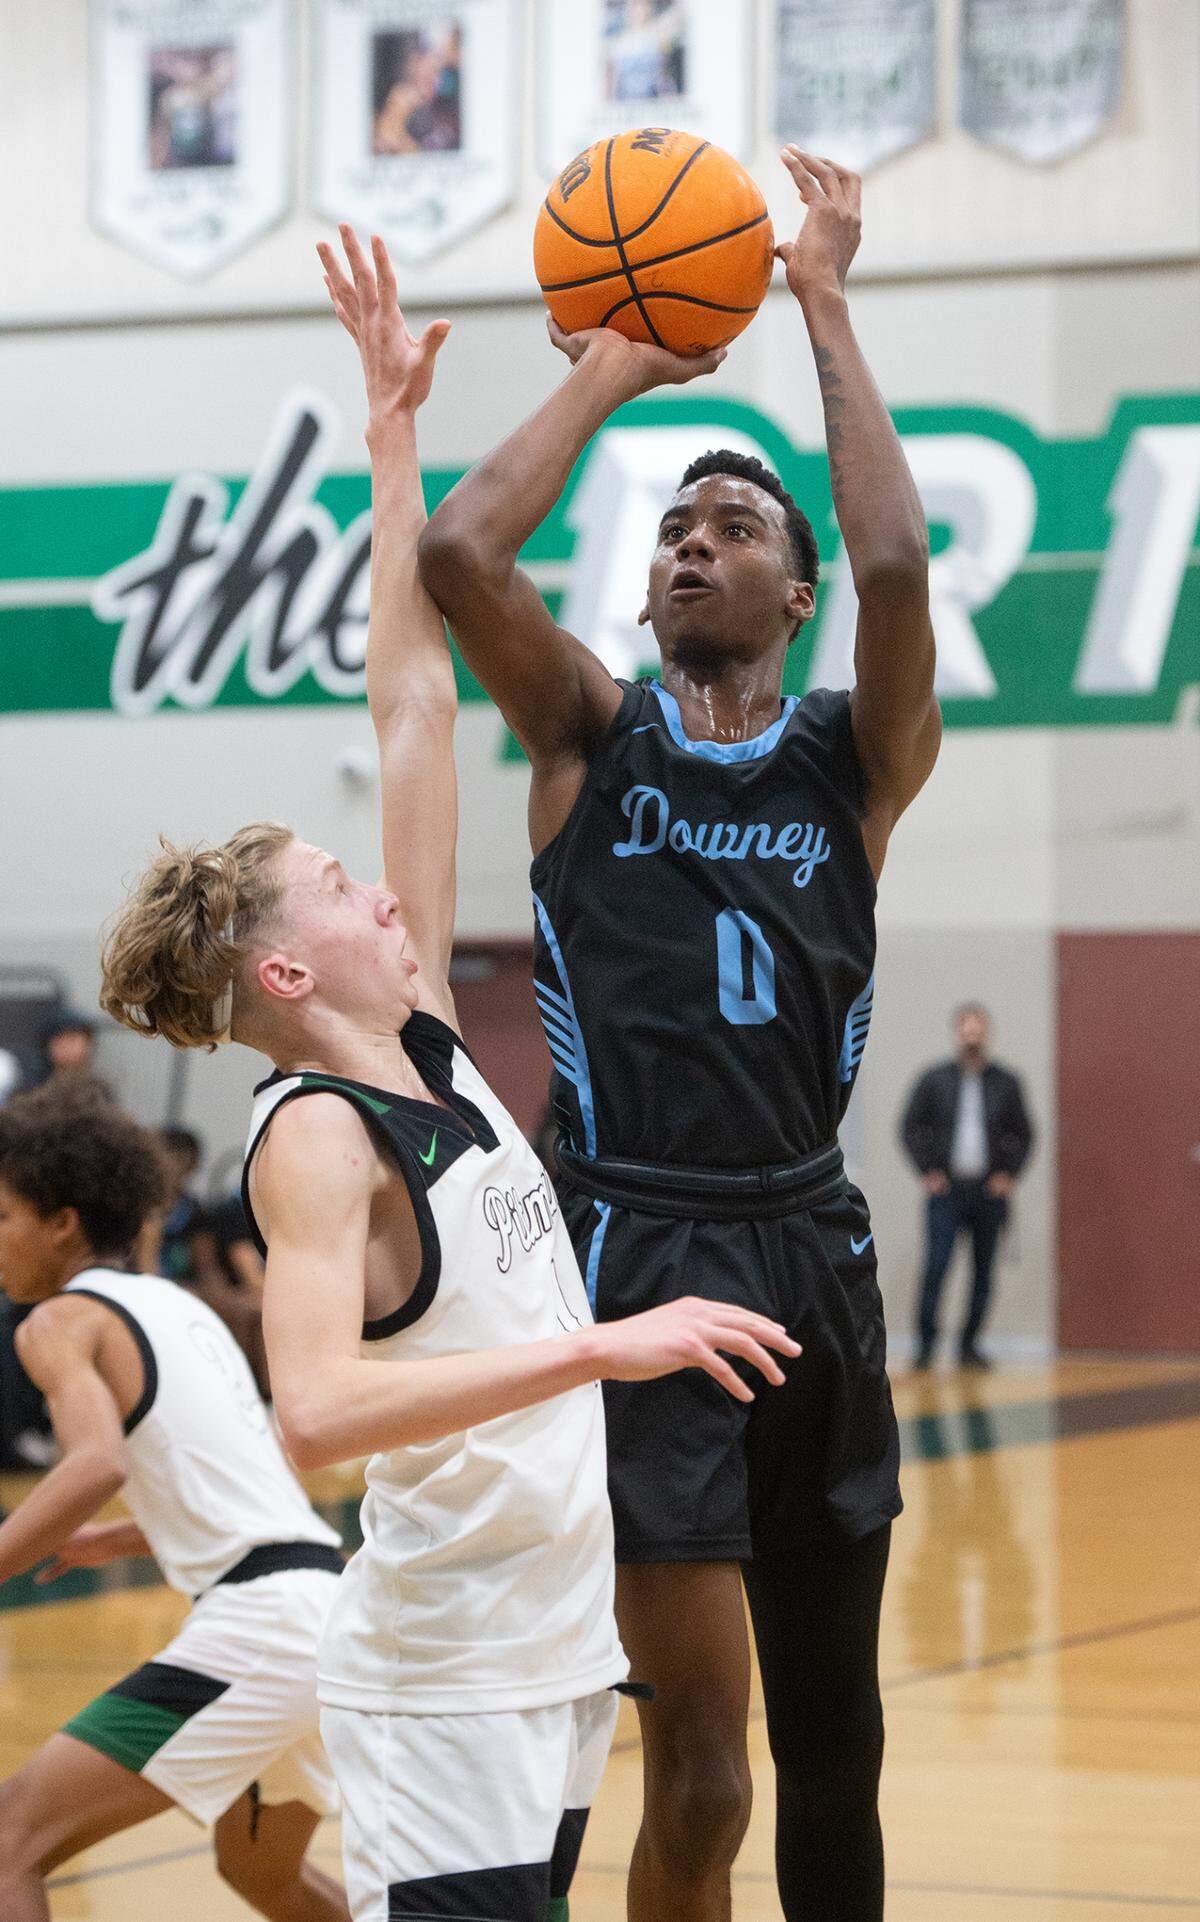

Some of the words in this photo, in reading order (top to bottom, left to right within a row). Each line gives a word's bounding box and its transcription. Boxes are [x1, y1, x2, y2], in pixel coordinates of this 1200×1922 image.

[108, 402, 371, 695] the
[612, 784, 831, 888] Downey
[715, 906, 778, 1025] 0
